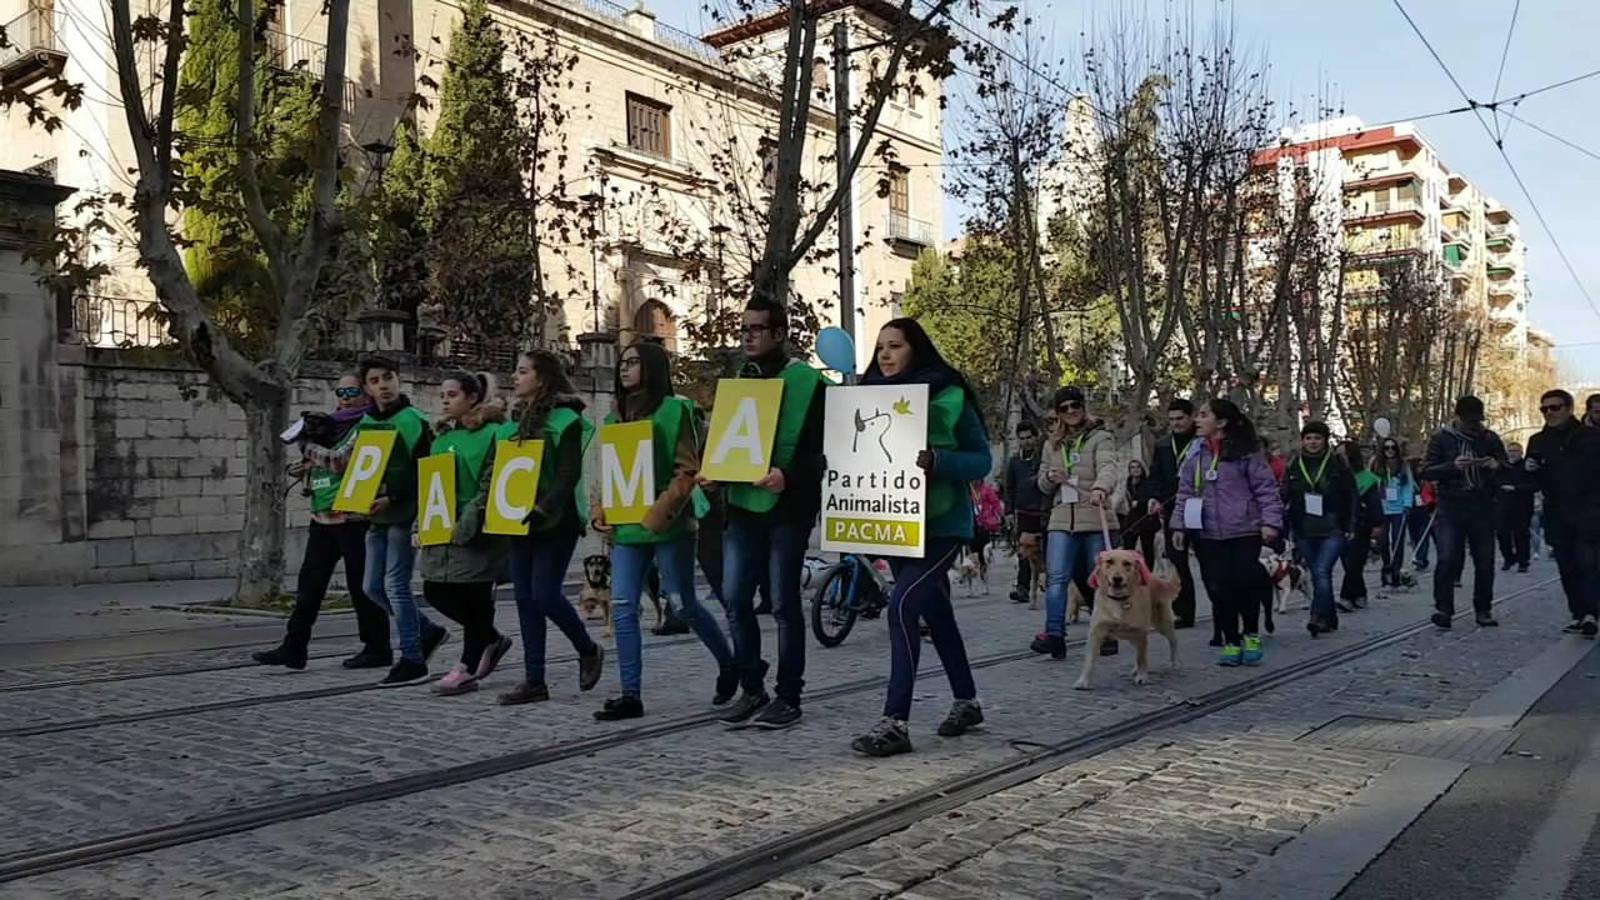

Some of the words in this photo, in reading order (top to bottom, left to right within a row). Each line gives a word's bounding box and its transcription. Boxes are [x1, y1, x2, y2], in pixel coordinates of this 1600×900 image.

[709, 396, 765, 465] A
[345, 446, 381, 497] P
[495, 456, 536, 520] C
[602, 439, 655, 508] M
[827, 469, 921, 489] Partido
[422, 471, 452, 531] A
[826, 493, 920, 514] Animalista
[834, 521, 907, 542] PACMA
